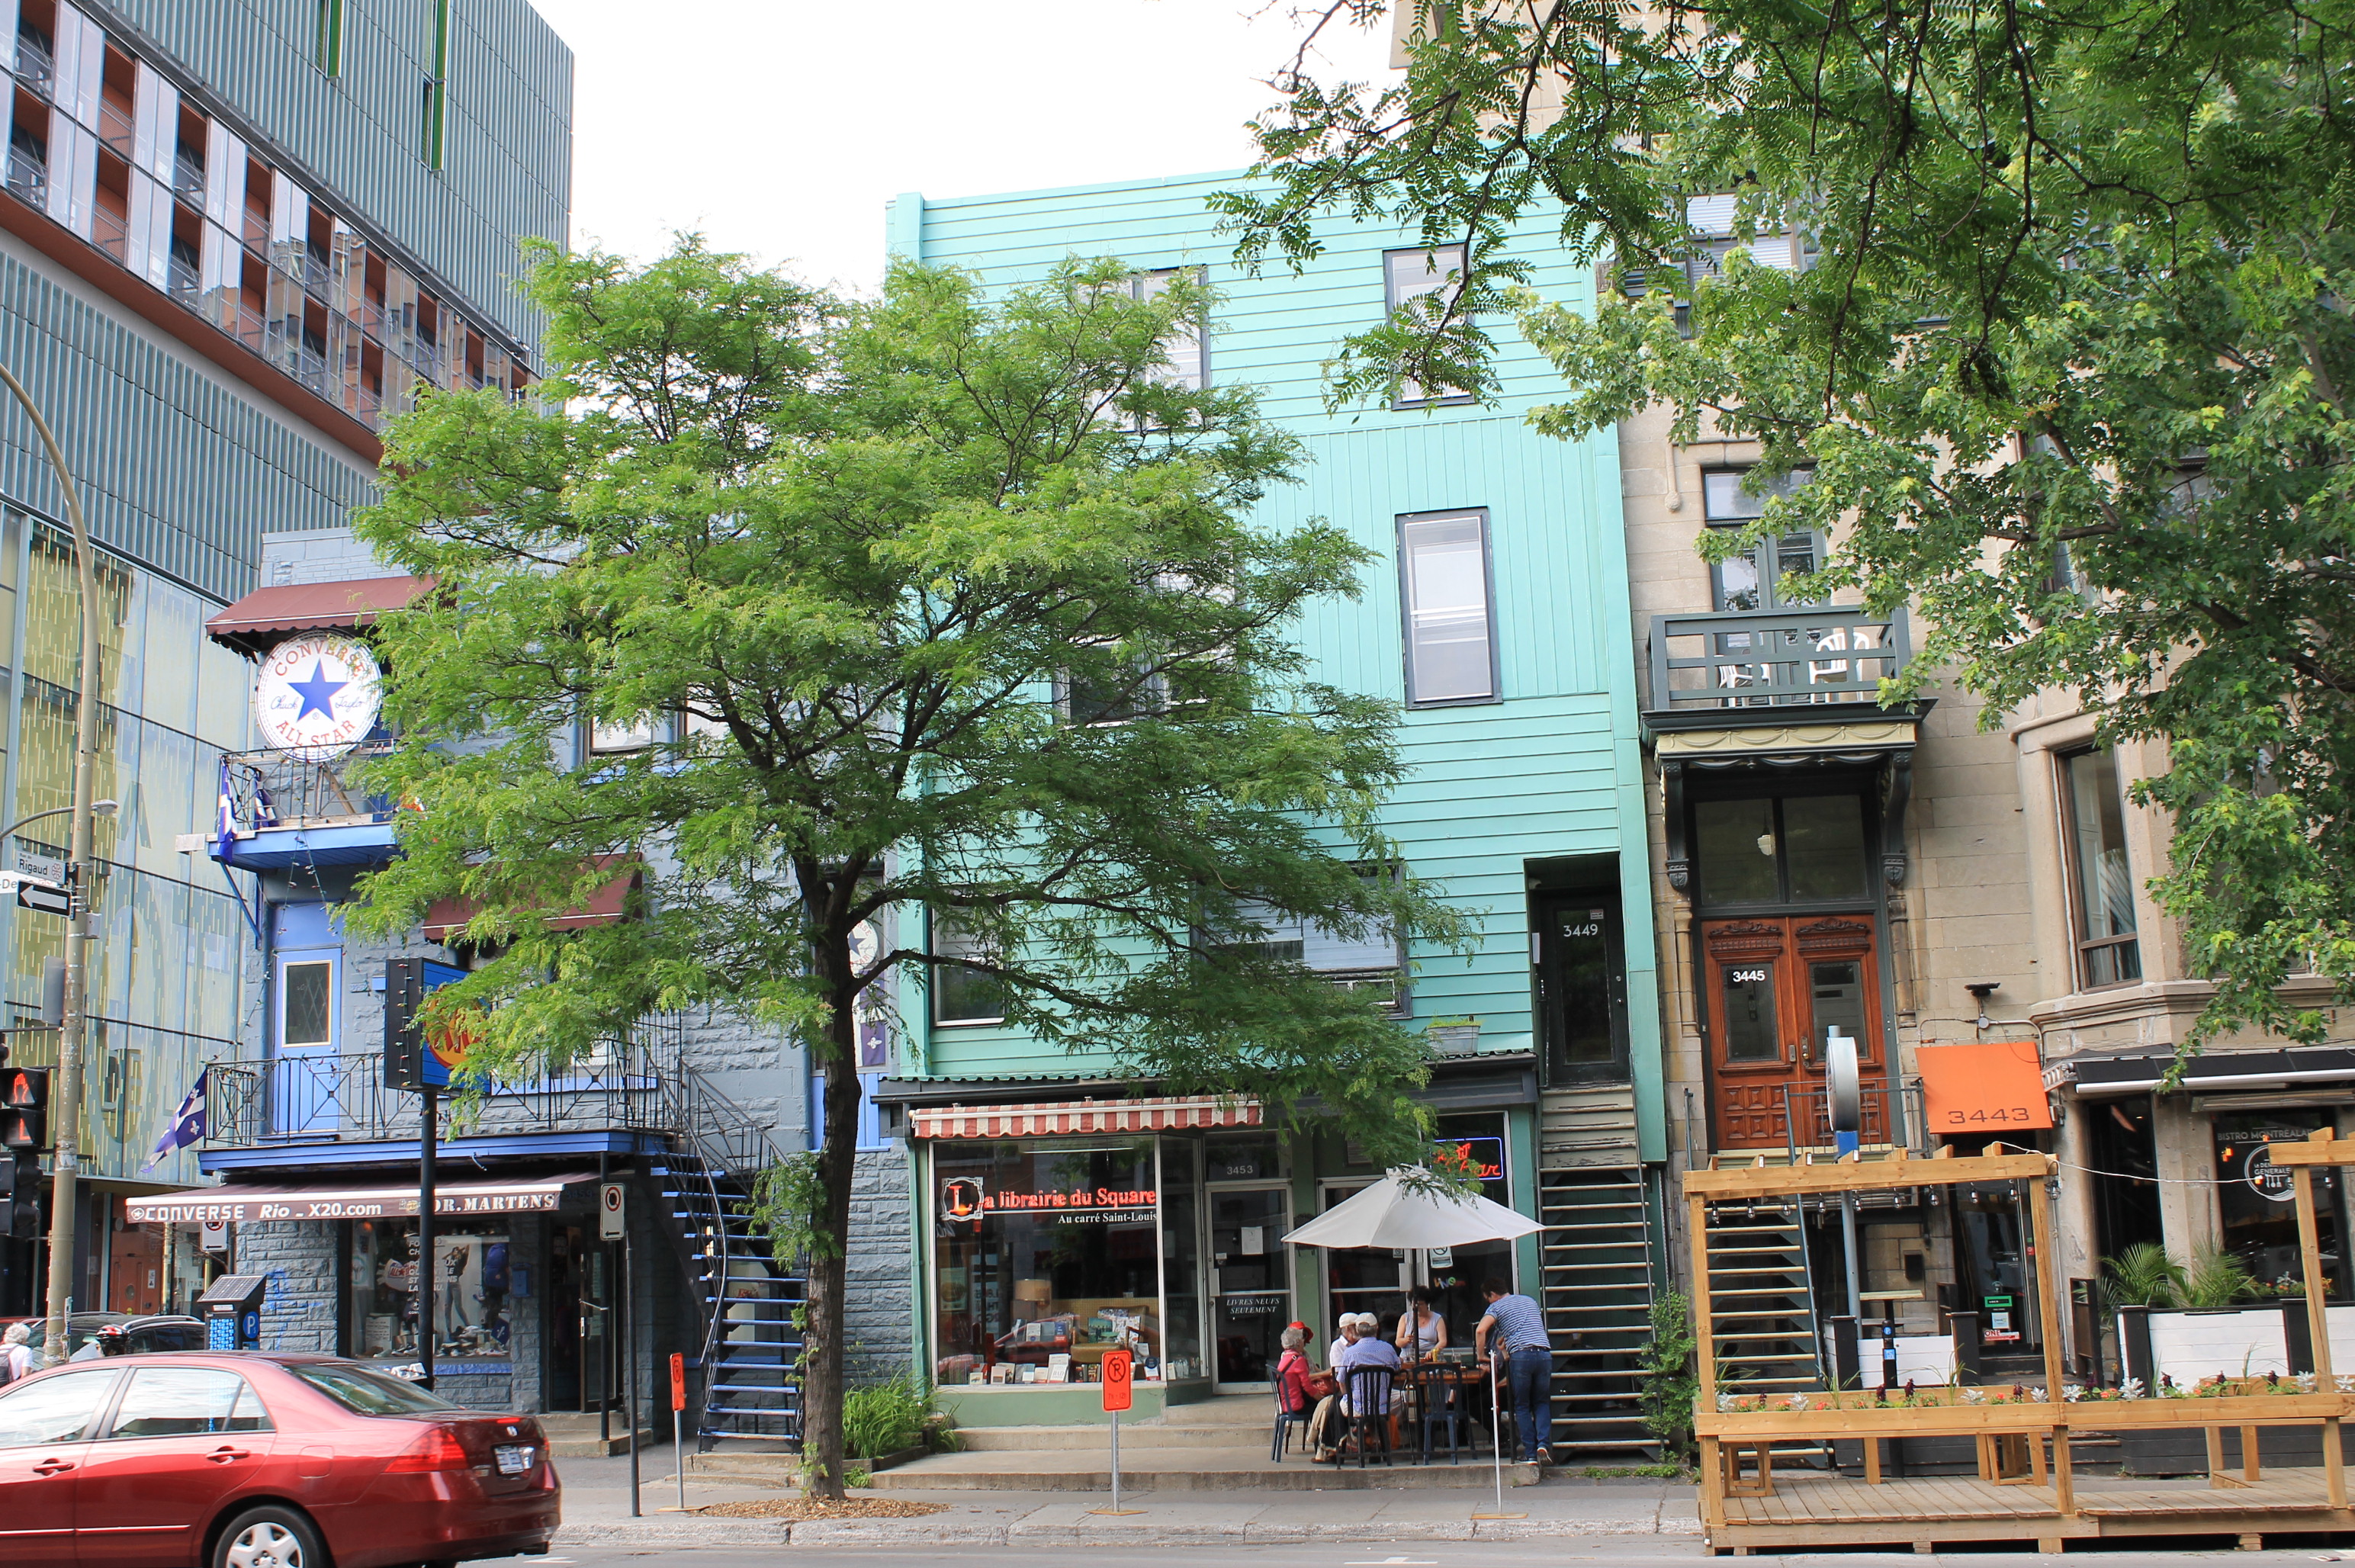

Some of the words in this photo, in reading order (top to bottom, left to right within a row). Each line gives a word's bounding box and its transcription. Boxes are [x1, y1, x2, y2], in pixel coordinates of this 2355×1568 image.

[275, 640, 366, 676] CONVERSE
[276, 721, 303, 747] ALL
[310, 720, 356, 747] STAR
[19, 859, 48, 875] Rigaud
[1563, 924, 1598, 937] 3449
[1733, 970, 1765, 982] 3445
[1948, 1107, 2030, 1124] 3443
[2217, 1131, 2248, 1141] BISTRO
[1227, 1165, 1253, 1175] 3453
[999, 1190, 1067, 1208] librairie
[1070, 1188, 1092, 1206] du
[1096, 1187, 1156, 1209] Square
[144, 1205, 245, 1221] CONVERSE
[259, 1203, 290, 1219] Rio
[308, 1203, 381, 1217] X20.com
[1058, 1214, 1072, 1223] Au
[1075, 1213, 1100, 1223] carré
[1103, 1211, 1157, 1223] Saint-Louis
